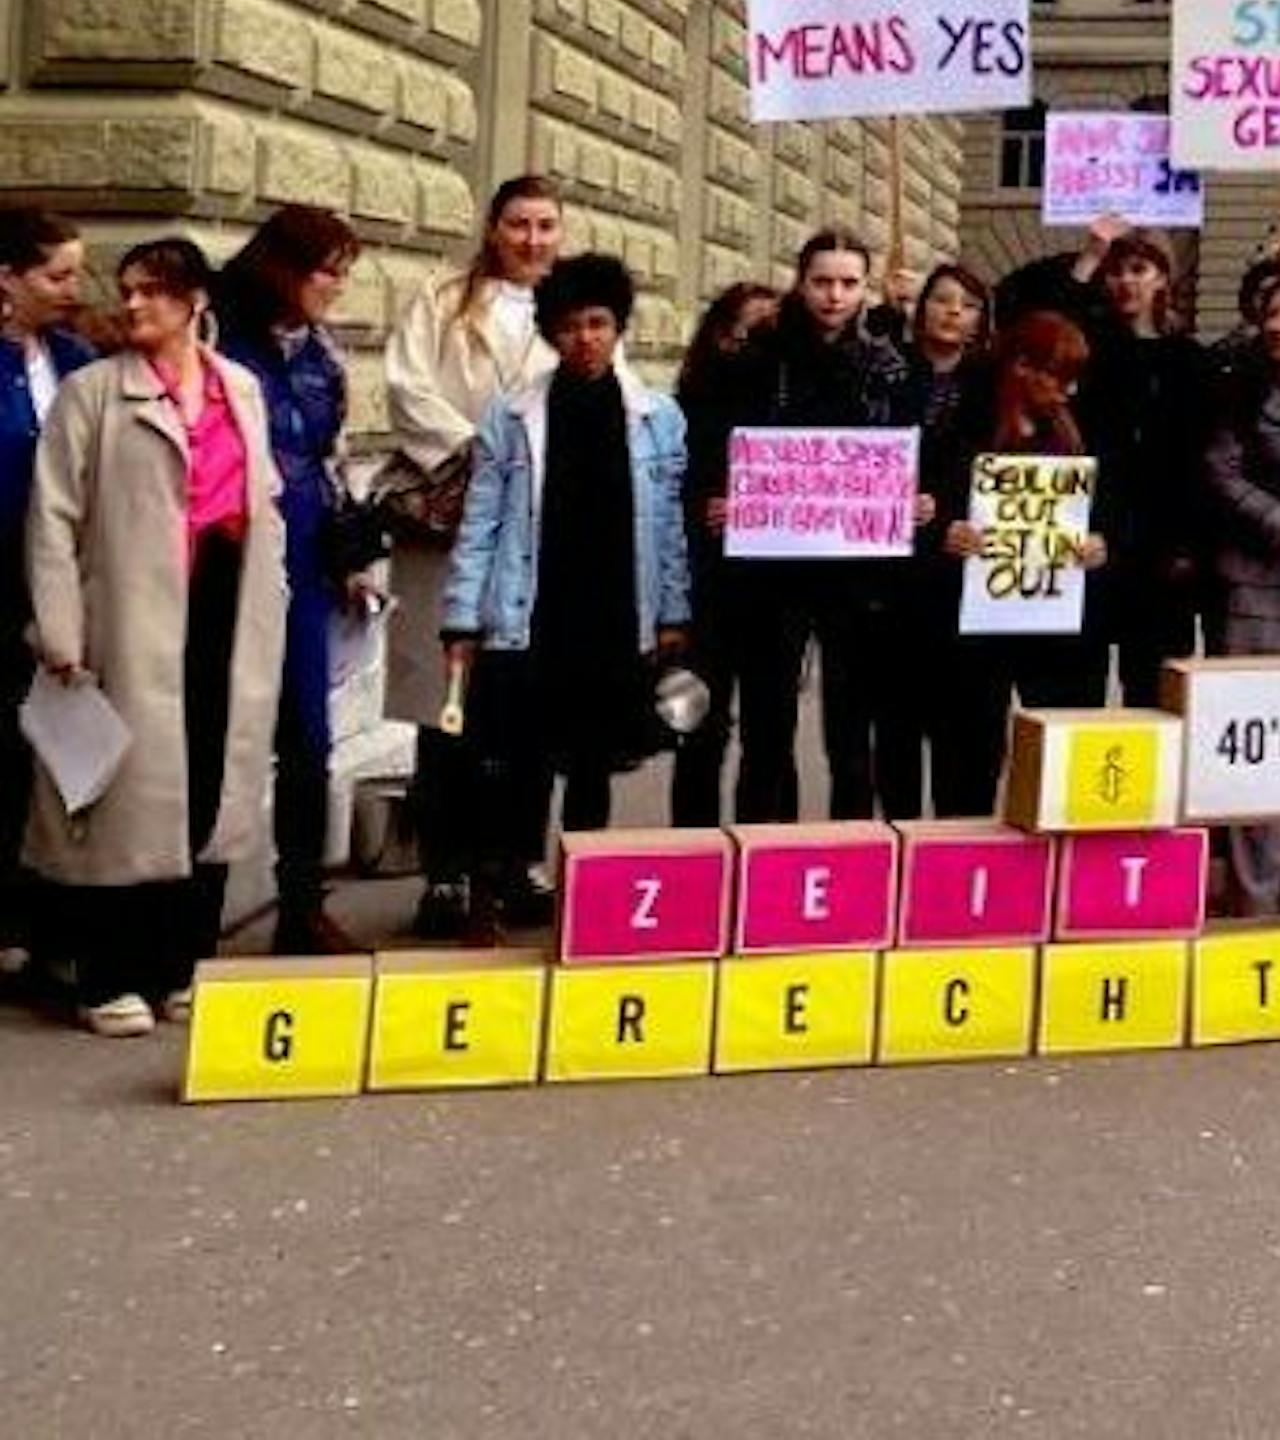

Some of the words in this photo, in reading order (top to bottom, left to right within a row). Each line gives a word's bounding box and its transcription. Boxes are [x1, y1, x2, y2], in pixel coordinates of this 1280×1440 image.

[757, 16, 915, 82] MEANS
[937, 17, 1025, 76] YES
[997, 496, 1057, 527] OUI
[980, 527, 1034, 559] EST
[986, 561, 1062, 599] OUI
